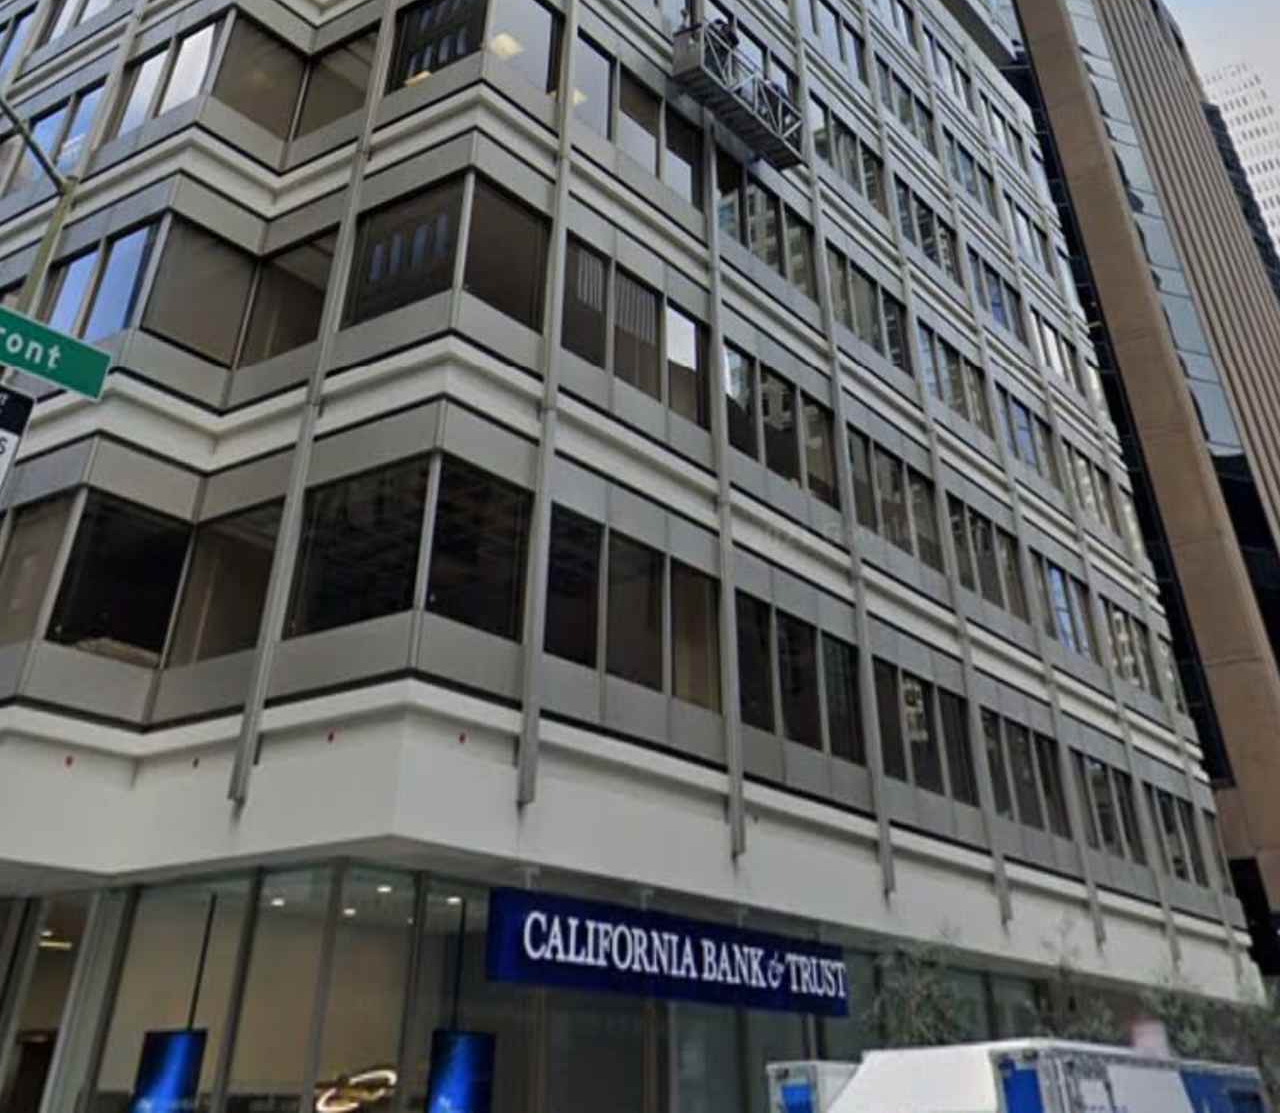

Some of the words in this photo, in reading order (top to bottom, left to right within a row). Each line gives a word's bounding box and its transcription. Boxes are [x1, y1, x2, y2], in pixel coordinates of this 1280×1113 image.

[523, 911, 698, 979] CALIFORNIA
[701, 939, 767, 989] BANK
[768, 951, 786, 988] &
[786, 953, 847, 998] TRUST
